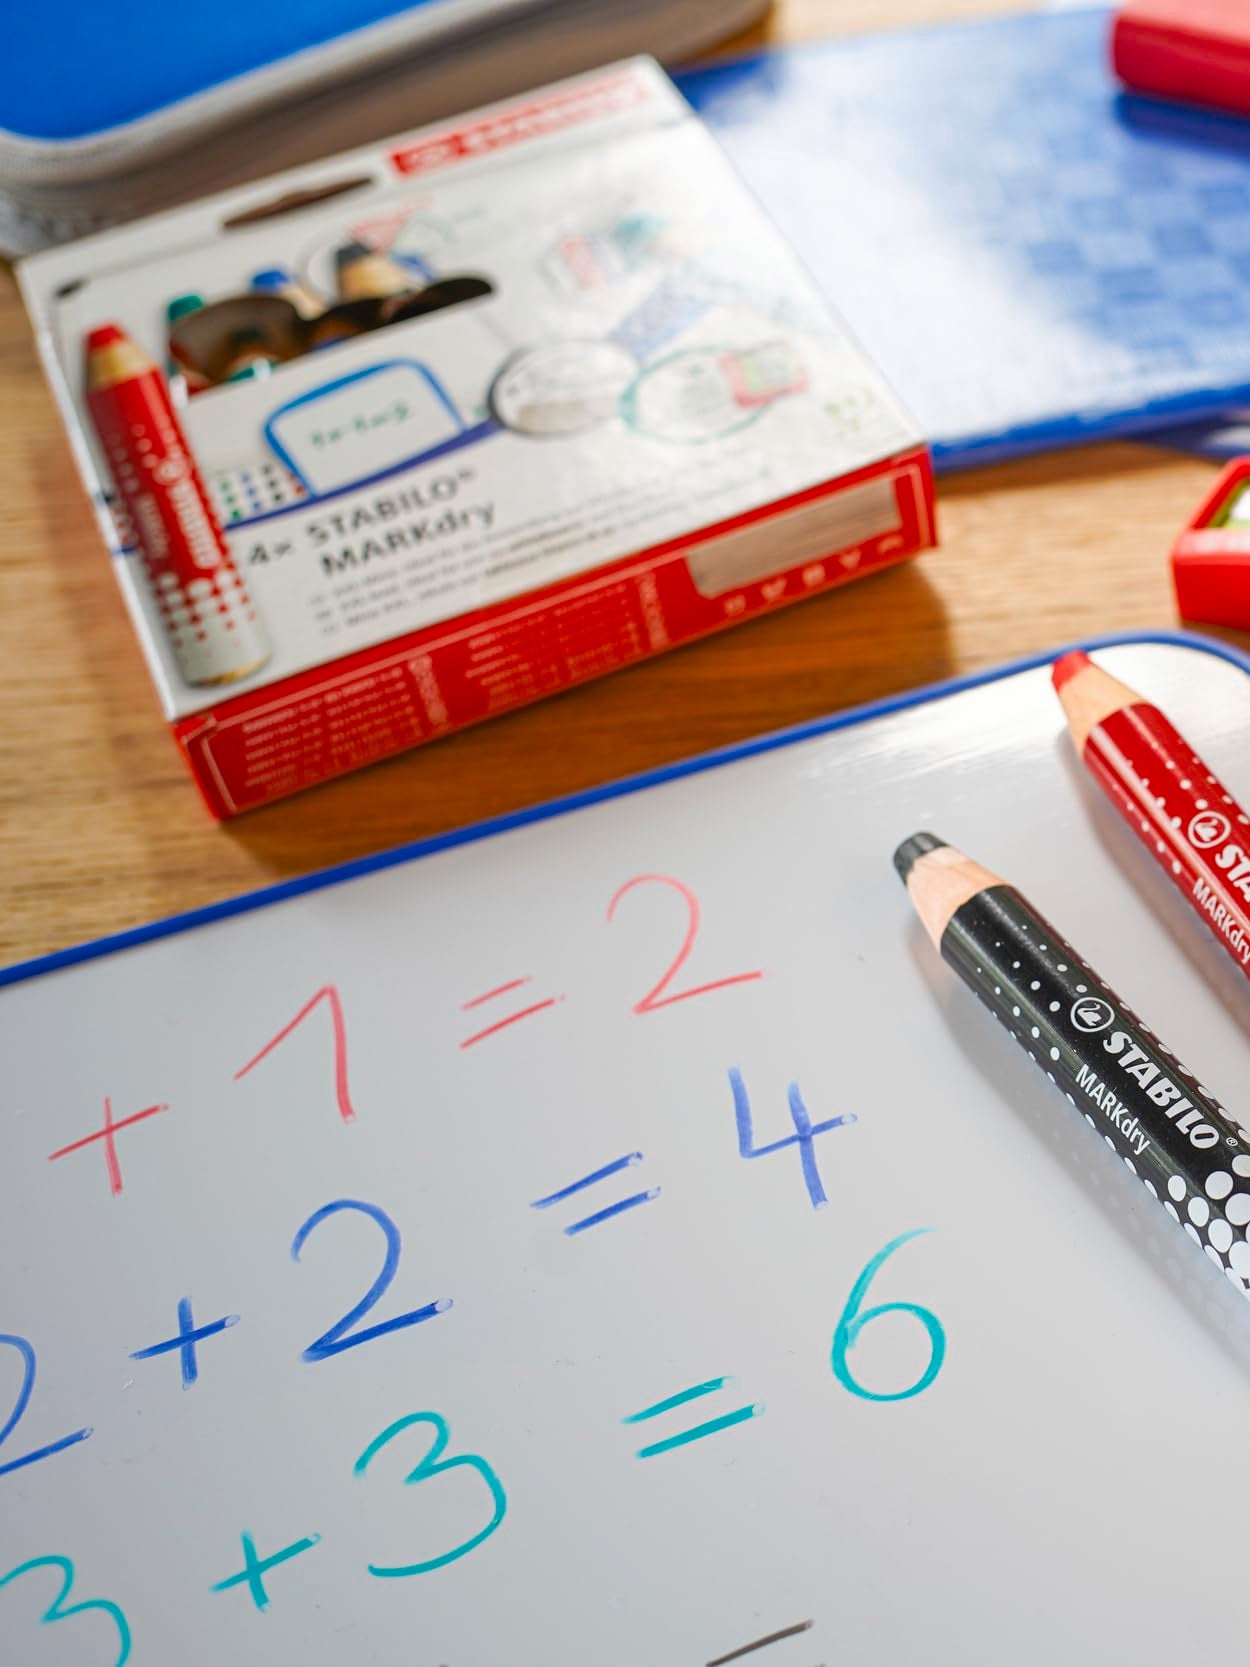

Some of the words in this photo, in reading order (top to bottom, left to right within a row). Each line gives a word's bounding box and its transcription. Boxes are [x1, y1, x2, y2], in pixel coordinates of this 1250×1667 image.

[320, 502, 495, 576] MARKdry
[234, 984, 357, 1123] 1
[607, 874, 765, 1014] 2
[1075, 1063, 1151, 1156] MARKdry
[291, 1199, 453, 1362] 2
[728, 1066, 858, 1208] 4
[353, 1411, 507, 1577] 3
[830, 1226, 946, 1402] 6
